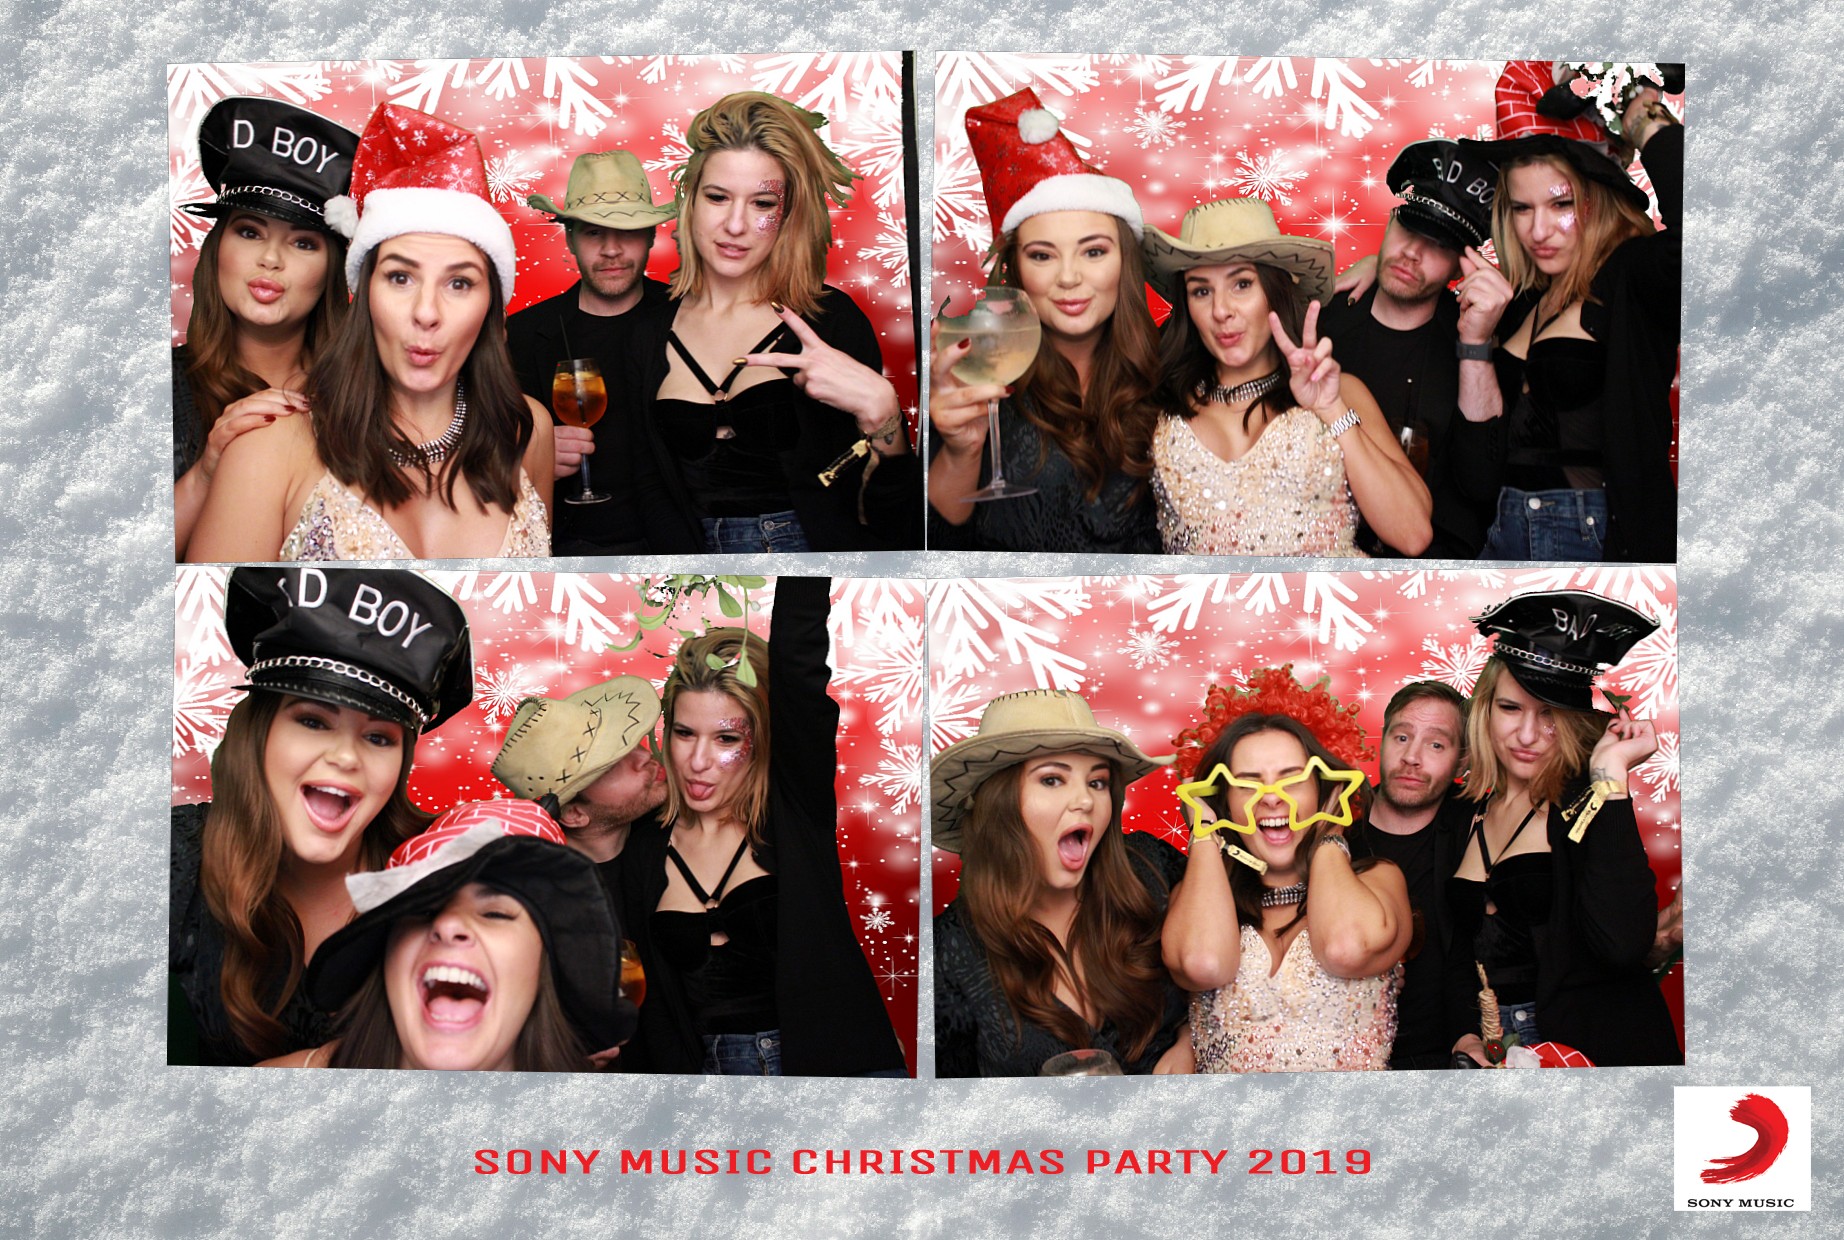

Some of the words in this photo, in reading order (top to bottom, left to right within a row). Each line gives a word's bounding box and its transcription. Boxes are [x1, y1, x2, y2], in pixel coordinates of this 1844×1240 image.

[272, 126, 339, 173] BOY
[1466, 177, 1496, 204] BO
[349, 583, 433, 648] BOY
